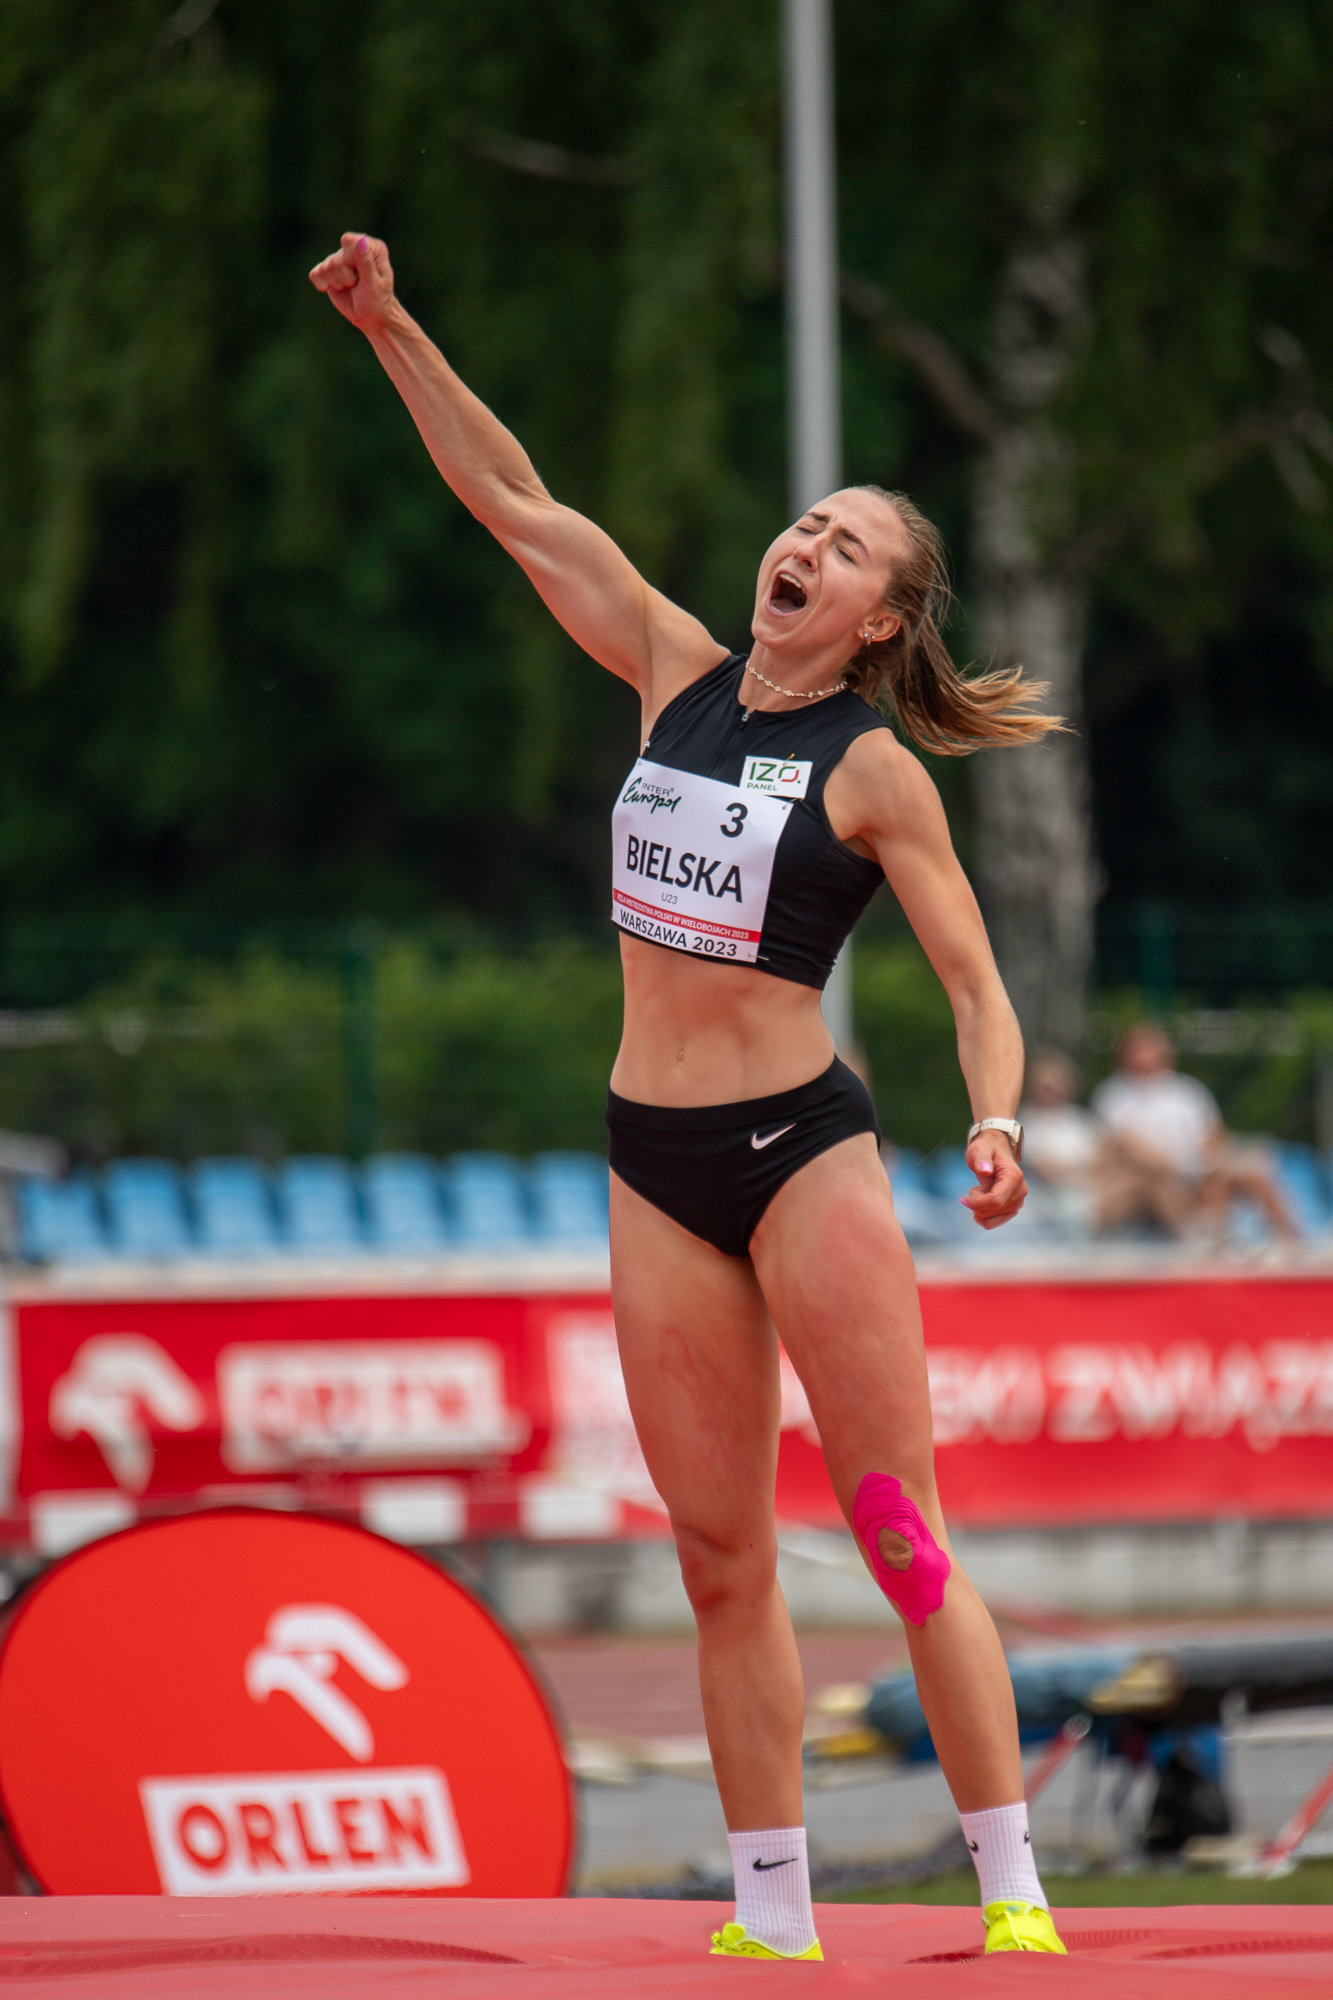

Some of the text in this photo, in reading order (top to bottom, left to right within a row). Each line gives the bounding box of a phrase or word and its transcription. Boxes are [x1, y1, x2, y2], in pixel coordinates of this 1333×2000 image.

[622, 776, 682, 814] Europol
[642, 782, 671, 797] INTER
[746, 782, 778, 792] PANEL
[719, 802, 749, 839] 3
[626, 833, 743, 904] BIELSKA
[661, 892, 678, 905] U23
[620, 908, 737, 957] WARSZAWA 2023
[653, 909, 673, 922] POLSKI
[672, 914, 681, 925] W
[680, 917, 731, 936] WIELOBOJACH
[731, 929, 749, 940] 2023
[175, 1796, 441, 1880] ORLEN
